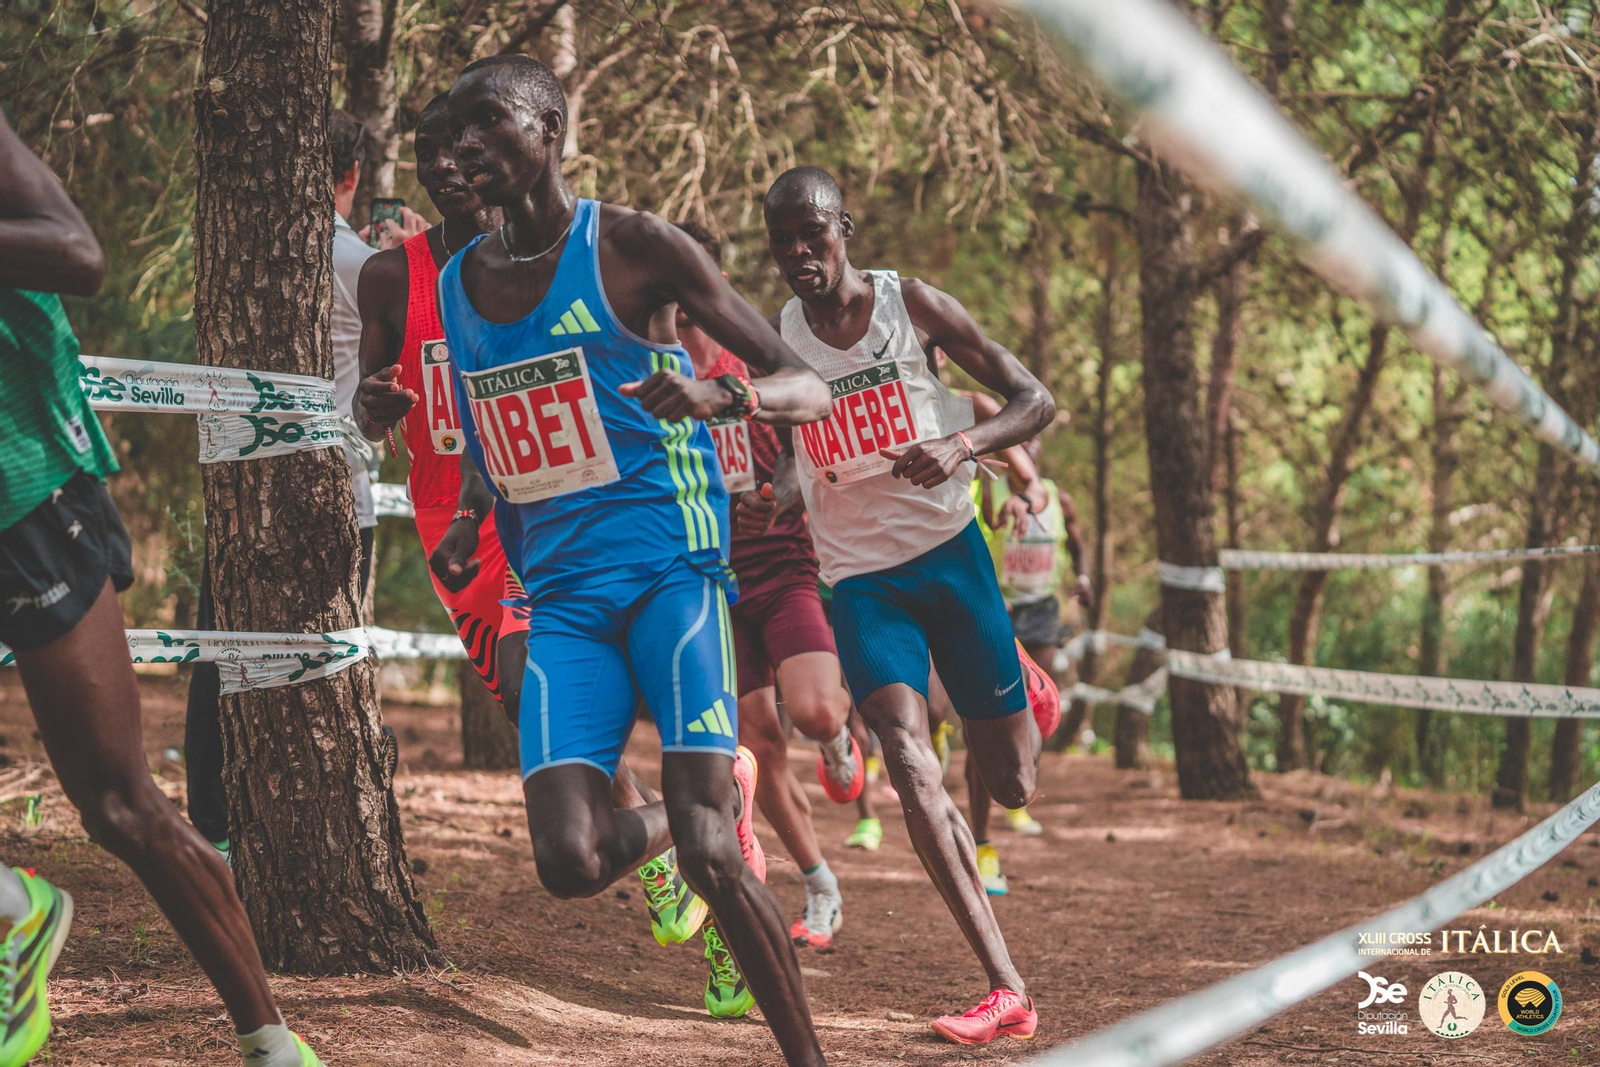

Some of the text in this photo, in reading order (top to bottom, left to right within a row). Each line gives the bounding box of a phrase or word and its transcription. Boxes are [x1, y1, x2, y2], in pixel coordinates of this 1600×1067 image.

[131, 385, 185, 406] Sevilla
[478, 366, 546, 395] ITÁLICA
[471, 378, 597, 477] KIBET
[800, 380, 918, 469] MAYEBEI
